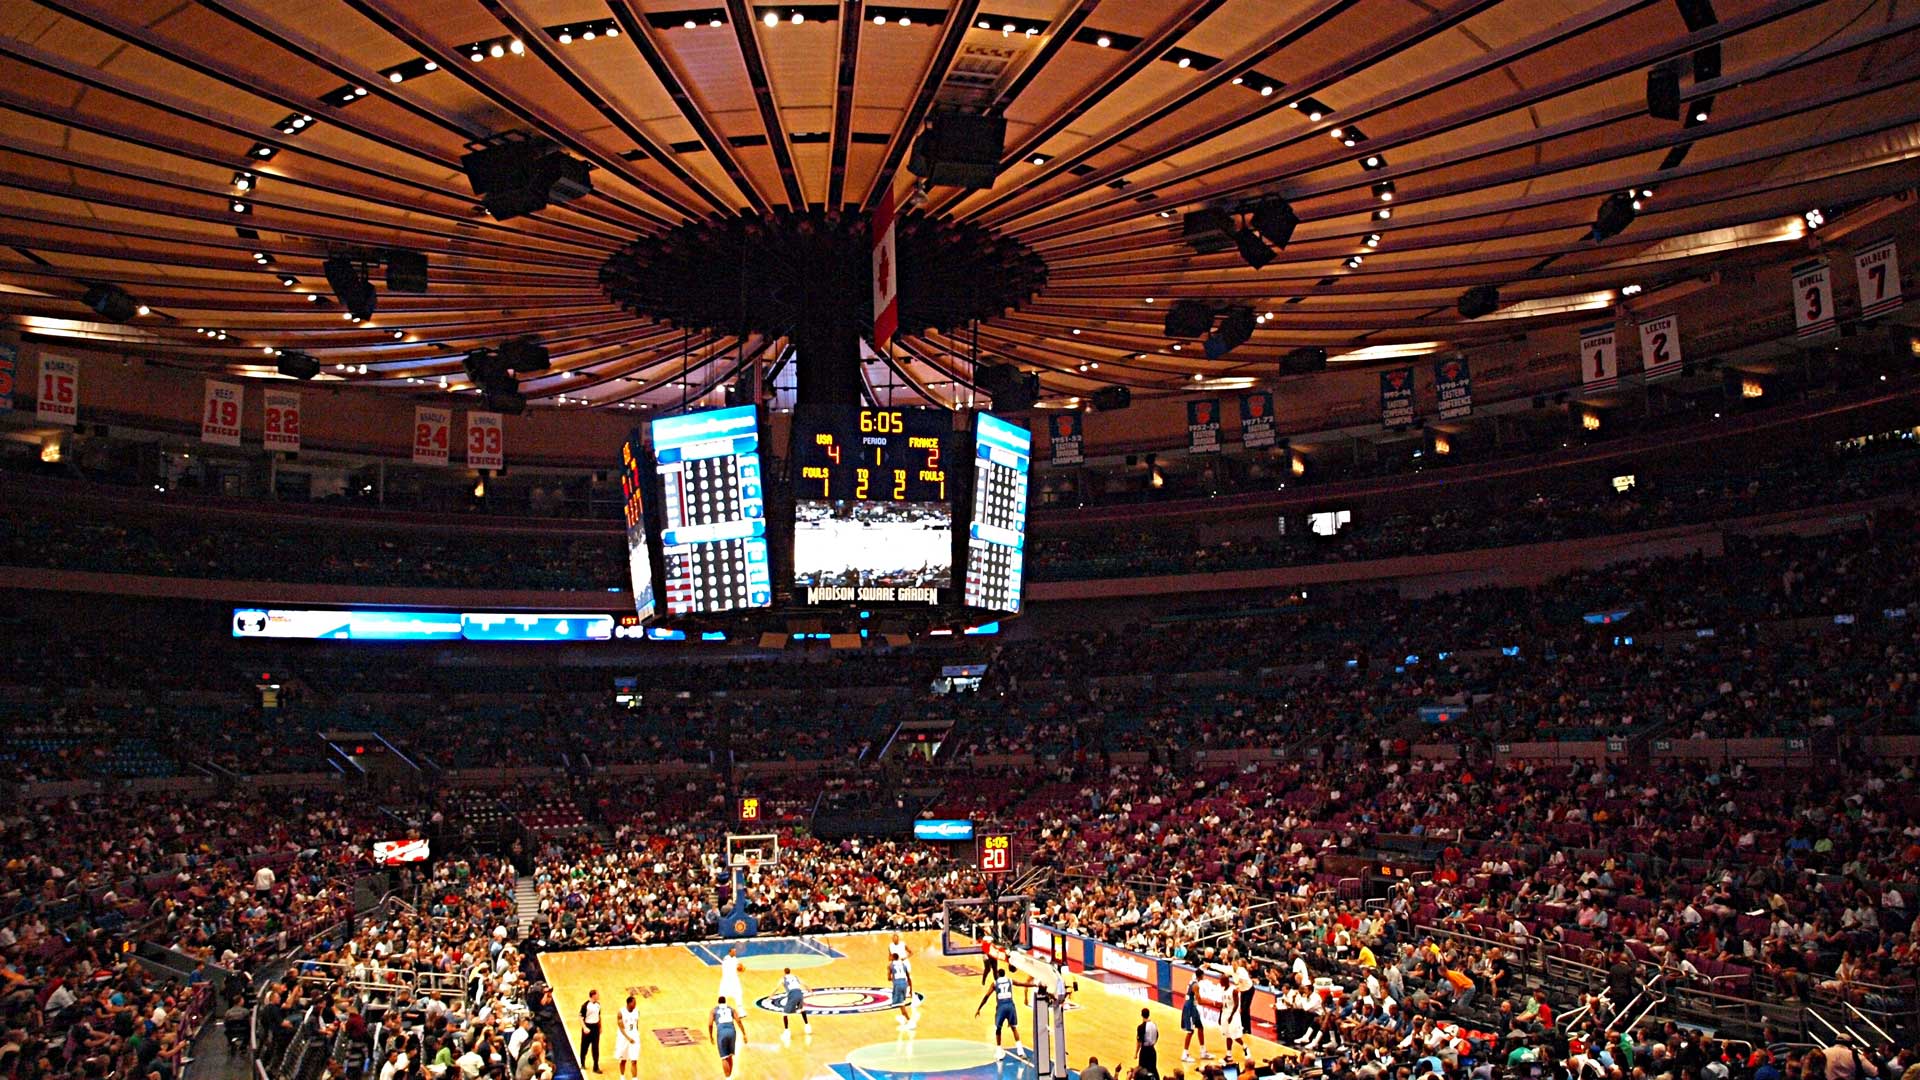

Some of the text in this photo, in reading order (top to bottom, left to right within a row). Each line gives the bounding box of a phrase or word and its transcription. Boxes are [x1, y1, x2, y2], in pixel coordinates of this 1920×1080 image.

[1868, 264, 1885, 300] 7
[1805, 287, 1821, 320] 3
[1645, 320, 1671, 334] LEETCH
[1652, 333, 1669, 364] 2
[1594, 350, 1604, 378] 1
[44, 374, 73, 403] 15
[209, 399, 238, 427] 19
[265, 408, 299, 434] 22
[860, 411, 903, 433] 6:05
[416, 423, 448, 449] 24
[469, 426, 502, 455] 33
[816, 434, 833, 445] USA
[862, 437, 887, 446] PERIOD
[909, 437, 939, 448] FRANCE
[828, 445, 840, 465] 4
[875, 447, 882, 466] 1
[927, 448, 940, 468] 2
[802, 467, 829, 479] FOULS
[857, 469, 869, 479] TO
[894, 470, 906, 480] TO
[919, 471, 945, 481] FOULS
[823, 479, 830, 498] 1
[856, 479, 869, 499] 2
[893, 480, 906, 500] 2
[939, 481, 946, 500] 1
[807, 586, 938, 605] MADISON SQUARE GARDEN
[621, 616, 638, 625] 1ST
[985, 836, 1009, 849] 6:05
[983, 848, 1005, 869] 20
